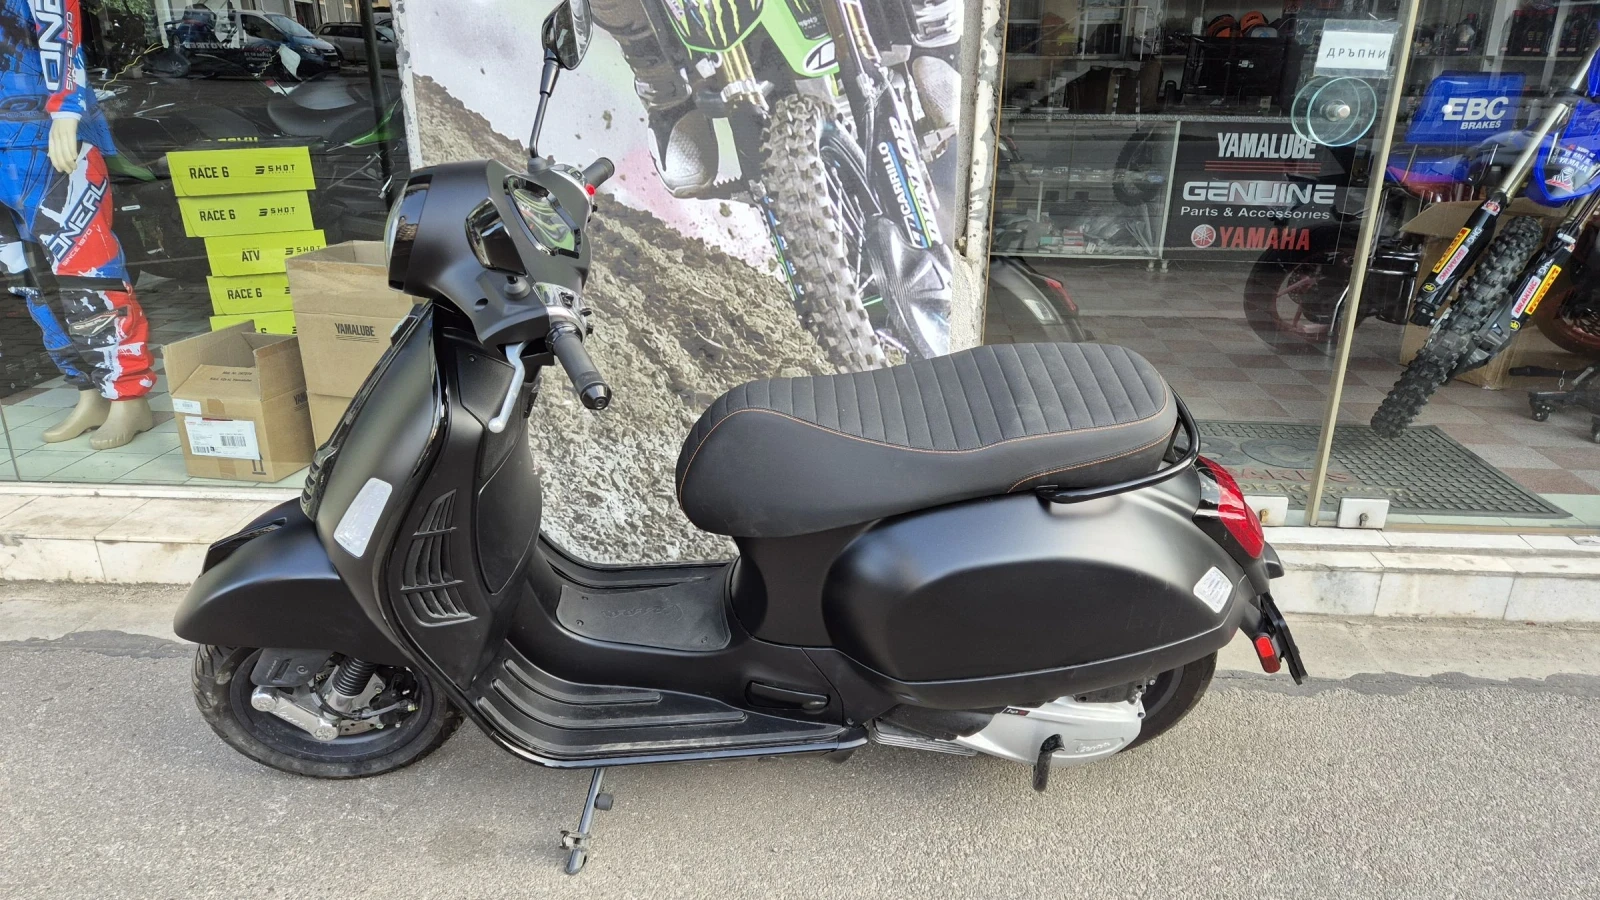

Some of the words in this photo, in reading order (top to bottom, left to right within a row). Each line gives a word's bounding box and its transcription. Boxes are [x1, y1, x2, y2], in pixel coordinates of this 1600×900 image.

[1326, 47, 1387, 59] ДРЪПНИ
[1444, 96, 1509, 121] EBC
[1460, 120, 1502, 130] BRAKES
[1217, 132, 1317, 159] YAMALUBE
[188, 166, 219, 180] RACE
[221, 166, 230, 178] 6
[267, 164, 296, 172] SHOT
[878, 141, 912, 216] CARRILLO
[1182, 181, 1337, 205] GENUINE
[199, 209, 227, 222] RACE
[229, 209, 236, 220] 6
[270, 206, 296, 215] SHOT
[1180, 206, 1219, 217] Parts
[1223, 207, 1234, 217] &
[1237, 207, 1331, 220] Accessories
[1219, 226, 1311, 251] YAMAHA
[241, 249, 261, 263] ATV
[296, 245, 321, 253] SHOT
[227, 288, 254, 300] RACE
[255, 287, 263, 298] 6
[1514, 280, 1539, 315] BRAKING
[334, 322, 376, 337] YAMALUBE
